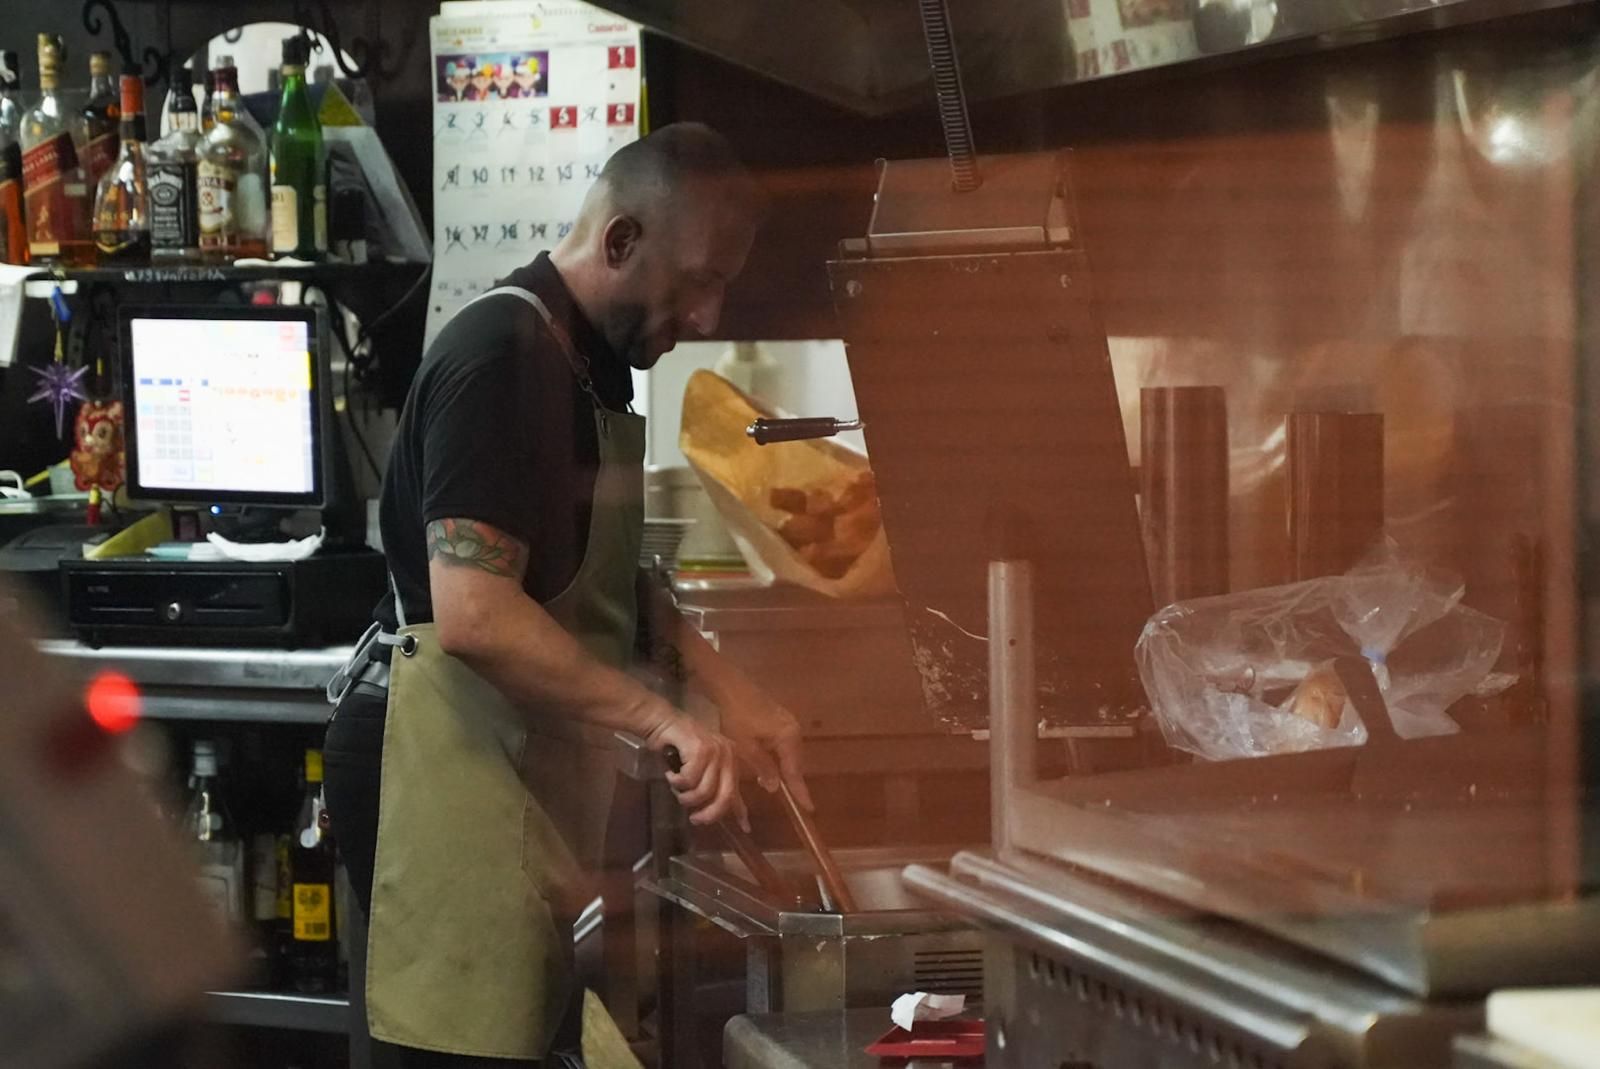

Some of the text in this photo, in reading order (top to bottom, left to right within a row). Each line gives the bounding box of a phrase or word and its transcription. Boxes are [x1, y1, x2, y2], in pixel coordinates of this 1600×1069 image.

[617, 47, 626, 65] 1
[558, 107, 570, 125] 6
[615, 103, 627, 123] 8
[472, 167, 489, 183] 10
[529, 166, 545, 182] 12
[472, 225, 489, 241] 17
